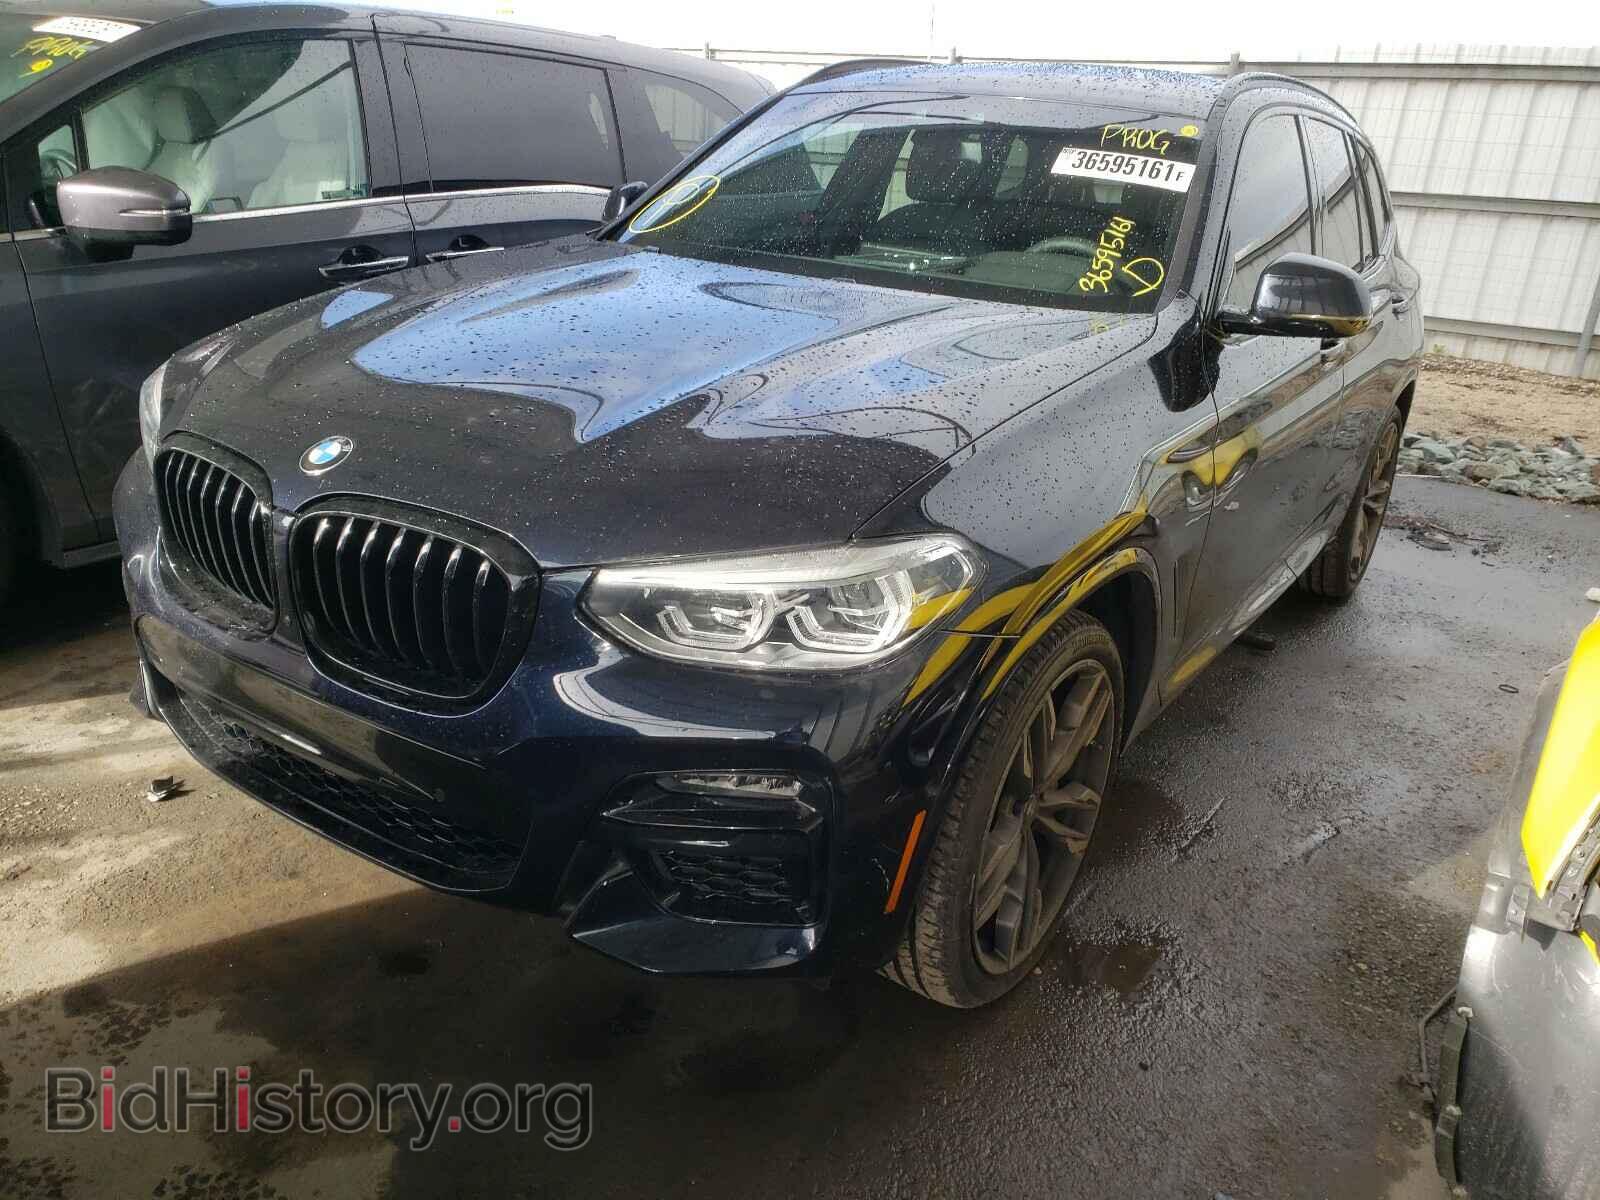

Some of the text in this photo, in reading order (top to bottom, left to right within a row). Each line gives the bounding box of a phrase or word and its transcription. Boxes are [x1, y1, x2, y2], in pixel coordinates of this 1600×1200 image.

[1100, 123, 1170, 155] PROG
[1071, 150, 1185, 182] 36595161 F
